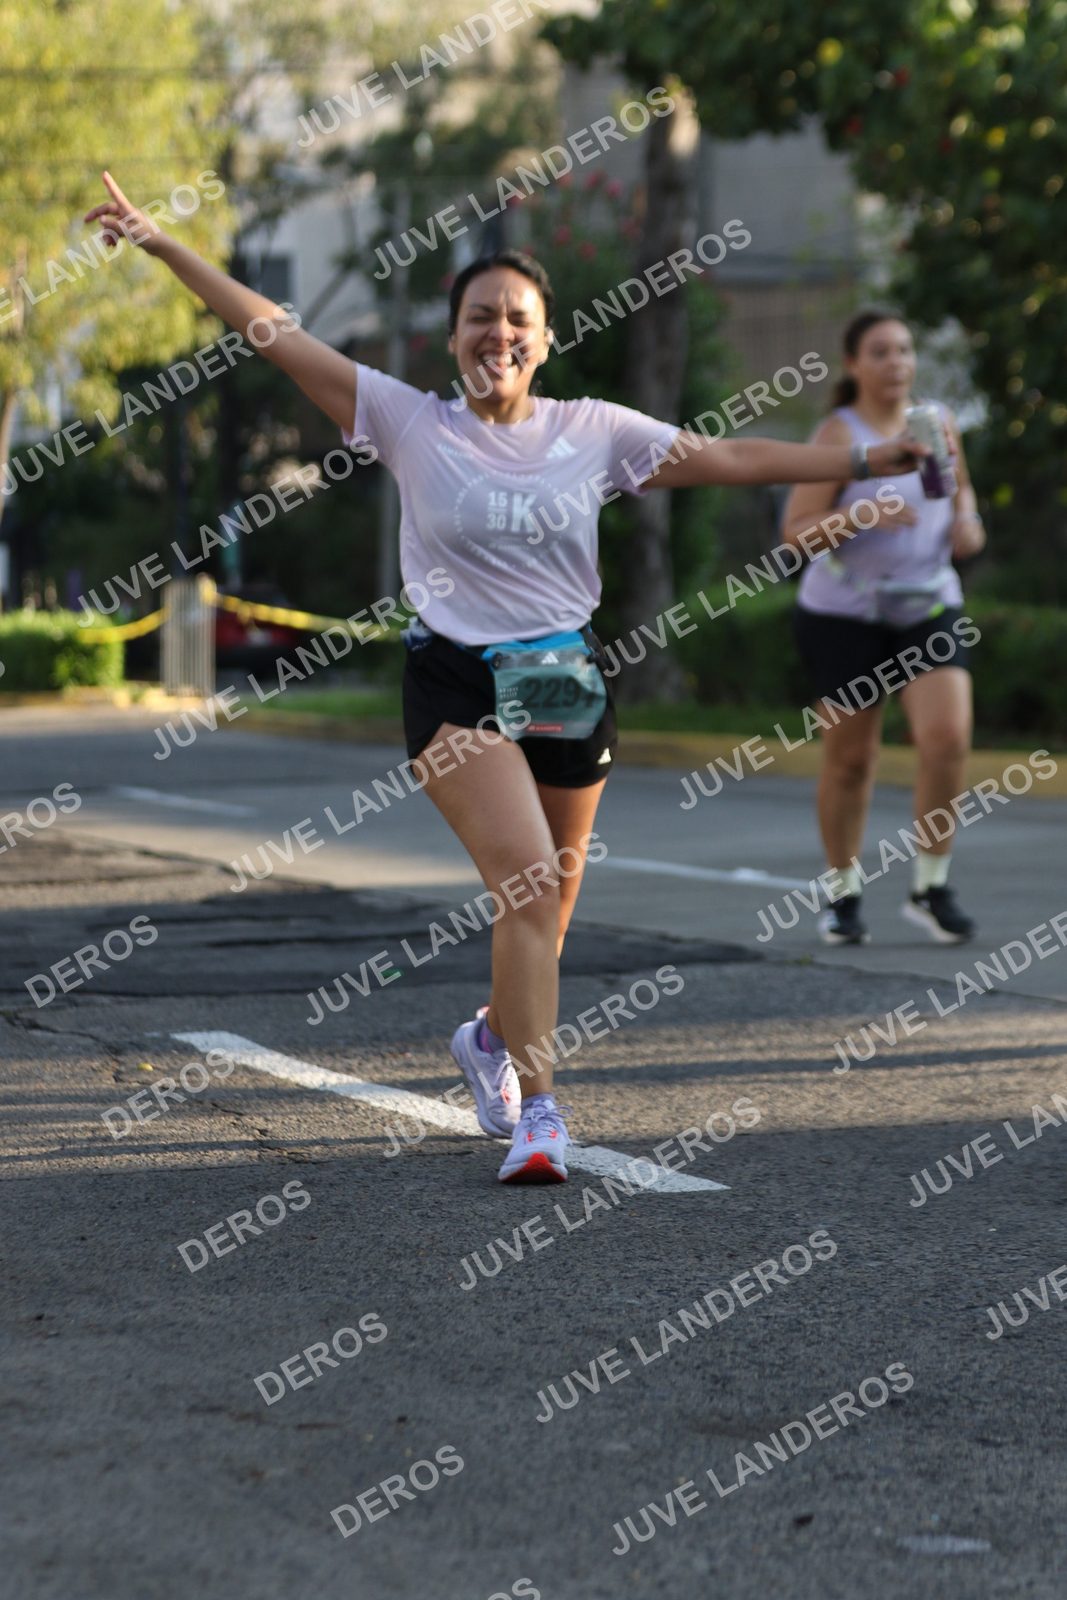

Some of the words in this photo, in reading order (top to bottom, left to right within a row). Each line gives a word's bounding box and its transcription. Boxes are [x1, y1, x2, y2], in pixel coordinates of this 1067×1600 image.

[487, 491, 508, 508] 15
[486, 512, 507, 531] 30
[511, 492, 538, 534] K
